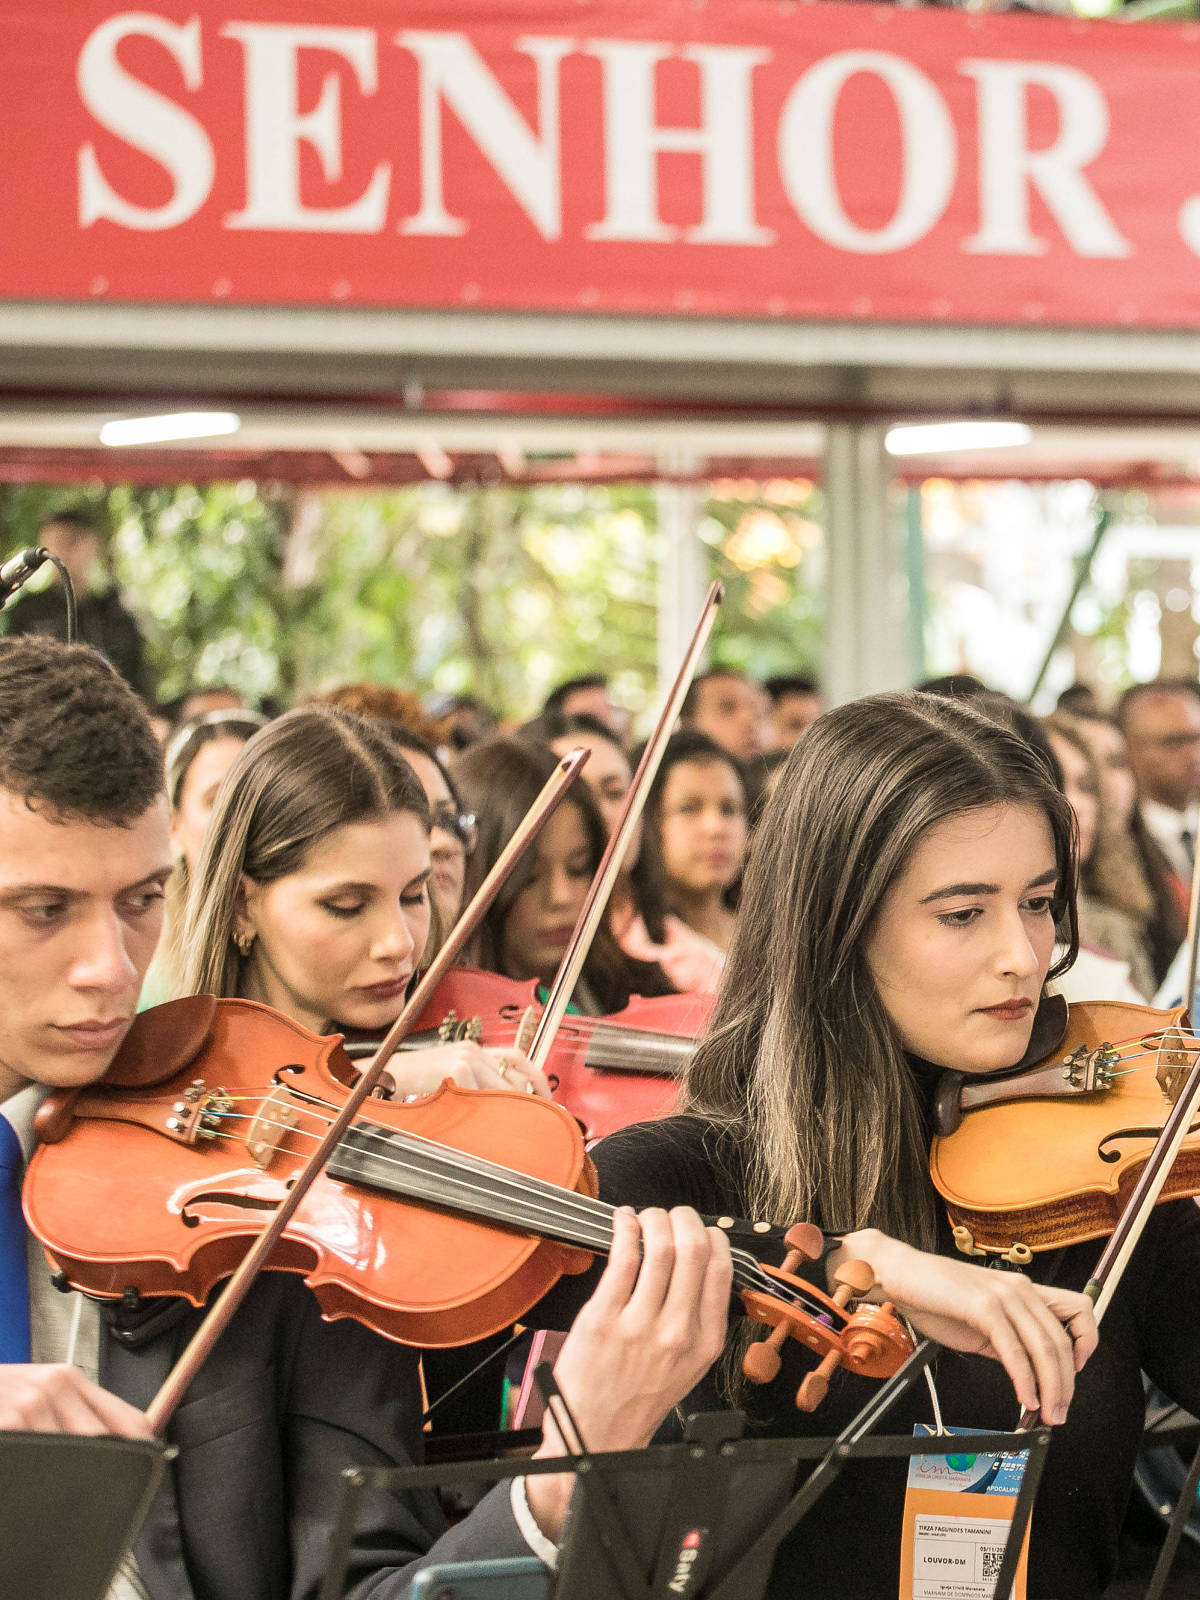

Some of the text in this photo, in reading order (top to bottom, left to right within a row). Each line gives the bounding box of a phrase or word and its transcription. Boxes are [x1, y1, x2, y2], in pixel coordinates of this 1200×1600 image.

[77, 10, 1134, 259] SENHOR
[934, 1526, 964, 1534] FAGUNDES
[923, 1556, 966, 1565] LOUVOR-DM
